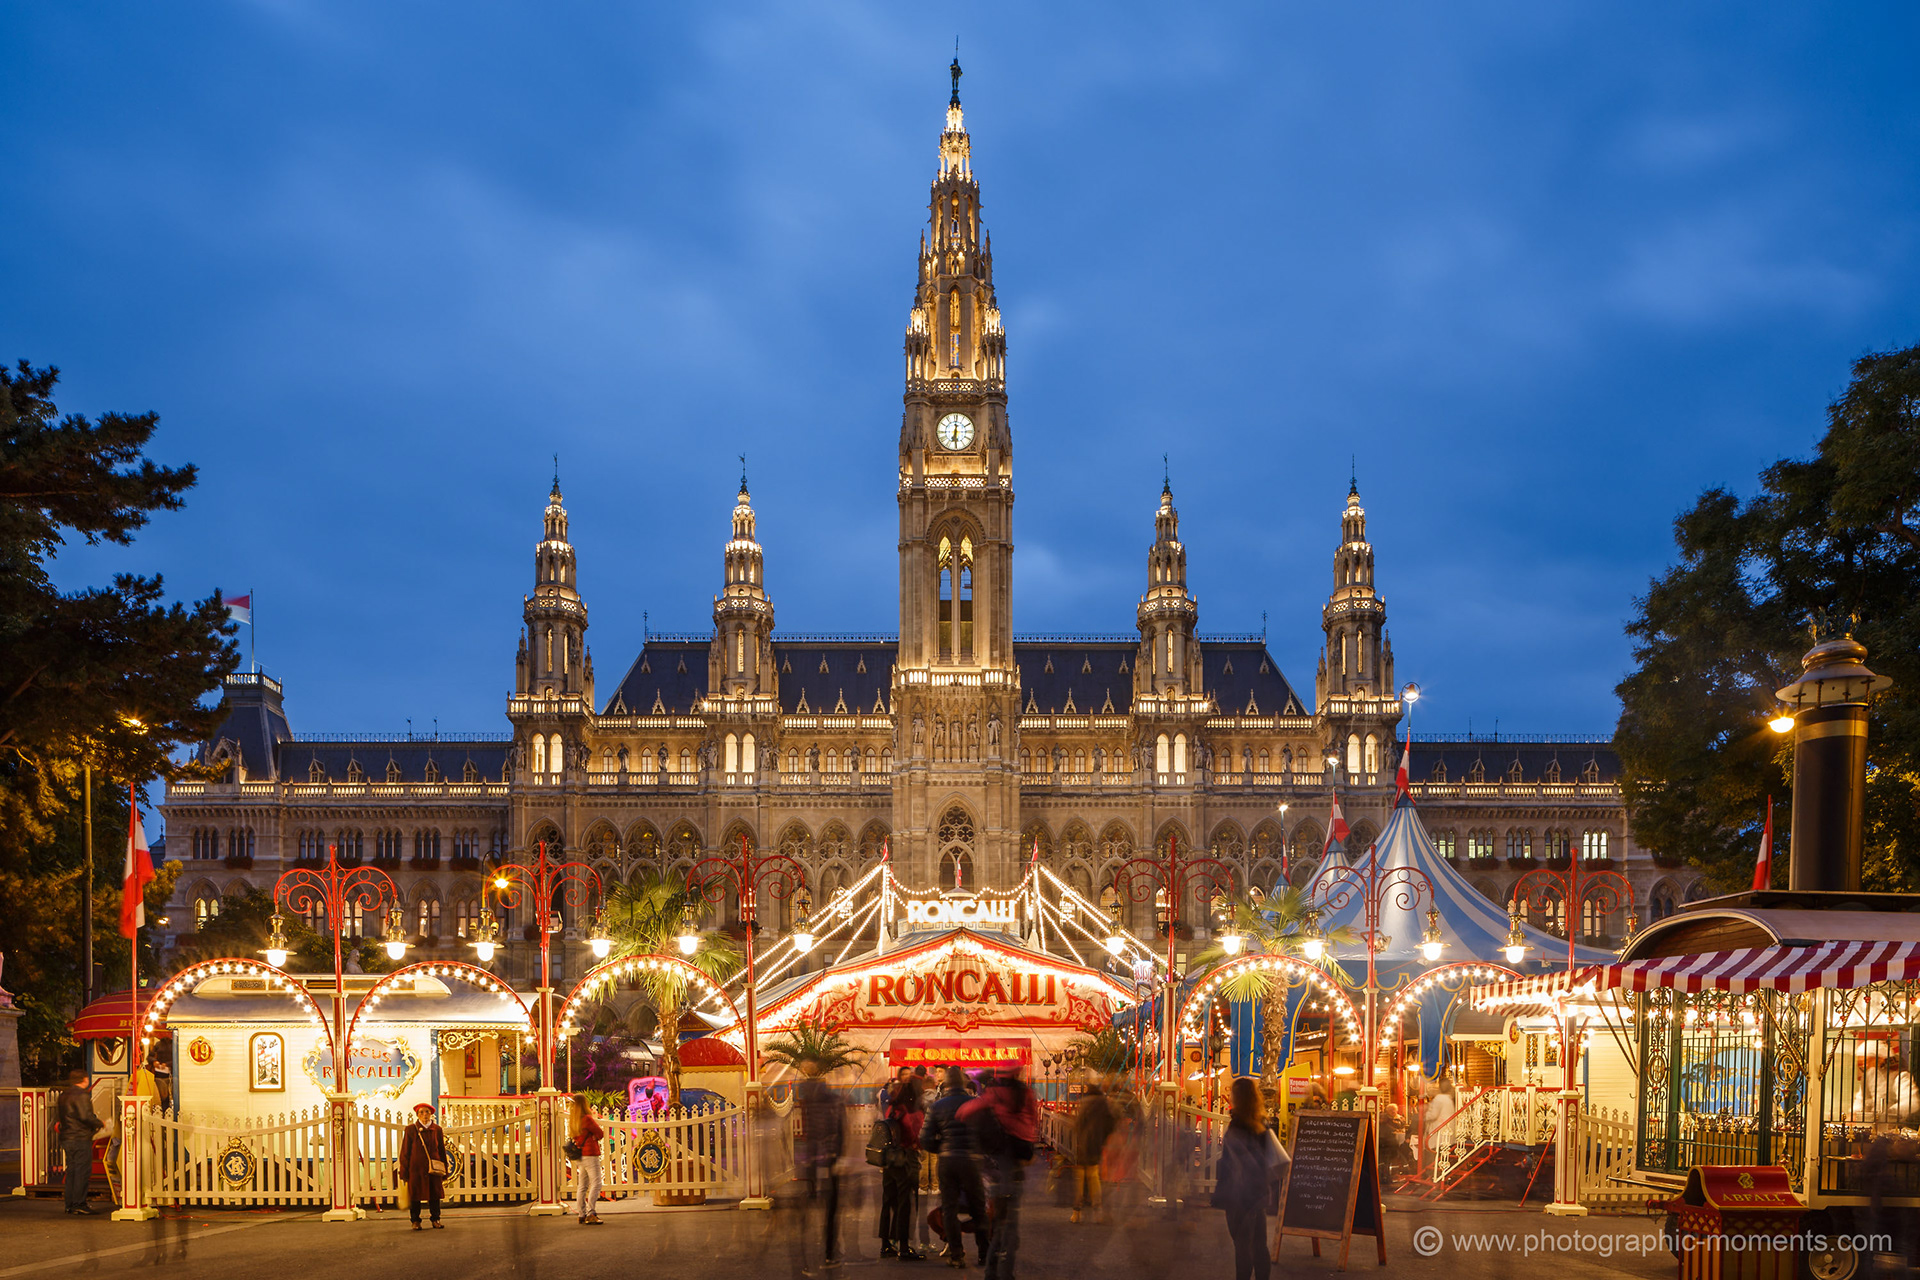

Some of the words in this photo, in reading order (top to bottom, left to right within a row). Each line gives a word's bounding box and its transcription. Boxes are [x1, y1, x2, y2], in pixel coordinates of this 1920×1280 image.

[907, 899, 1016, 923] RONCALLI
[867, 970, 1057, 1006] RONCALLI
[192, 1041, 209, 1060] 19
[904, 1047, 1019, 1061] RONCALLI
[322, 1065, 401, 1079] RNCALLI
[1722, 1193, 1786, 1202] ABFALL
